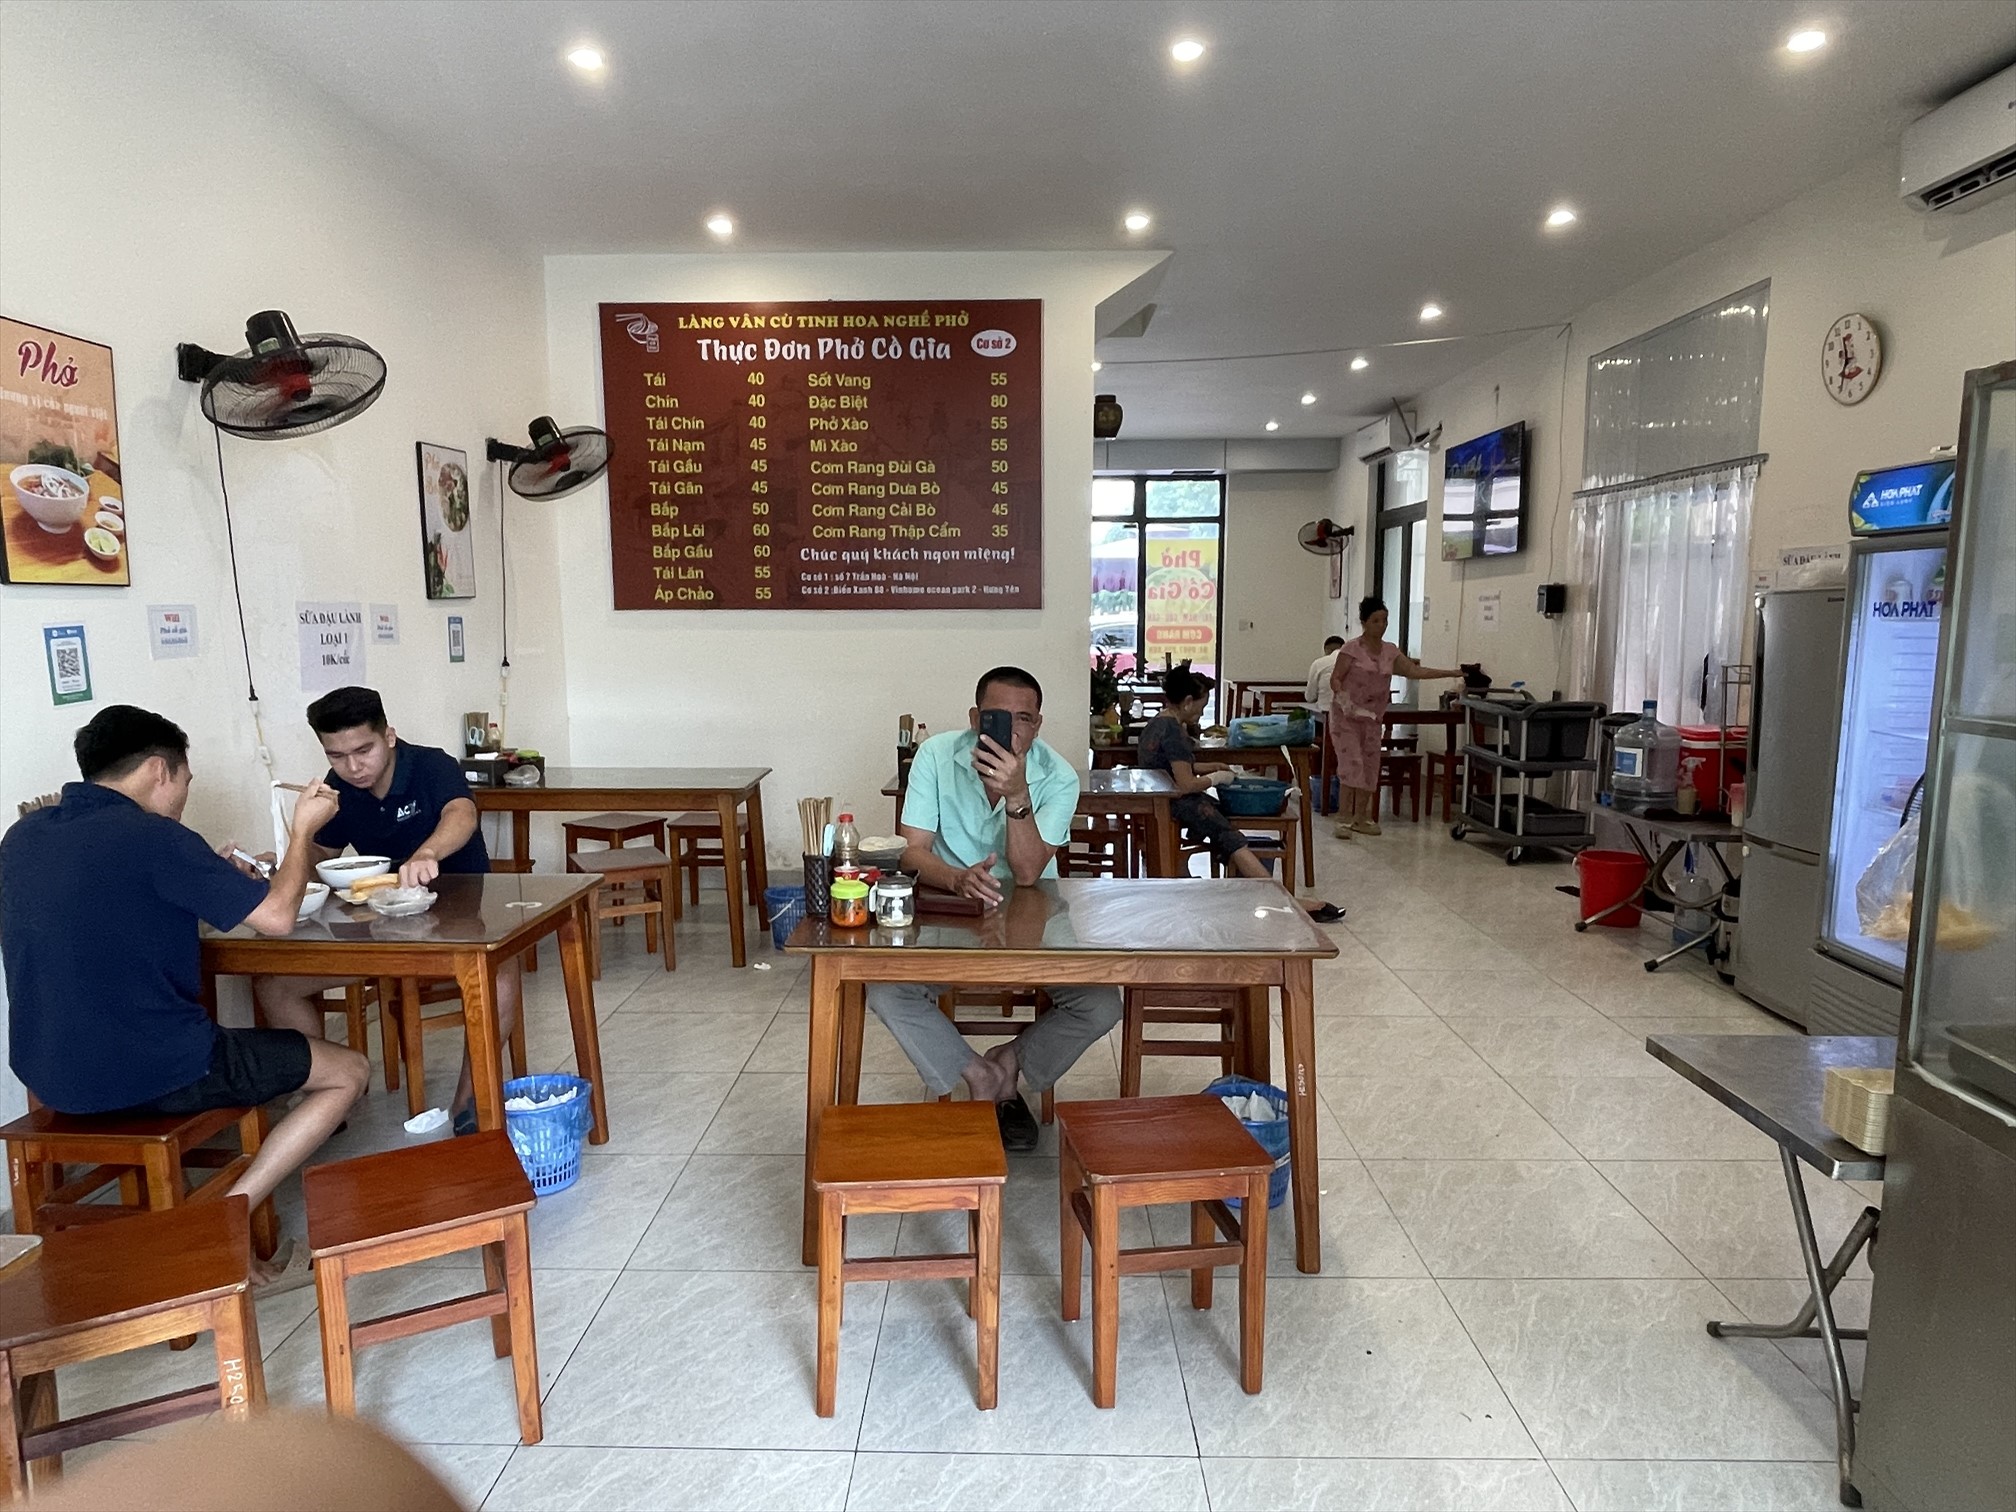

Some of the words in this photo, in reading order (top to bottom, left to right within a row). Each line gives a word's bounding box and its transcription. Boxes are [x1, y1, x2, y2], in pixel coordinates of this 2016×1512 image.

[678, 314, 724, 329] LÀNG
[729, 313, 766, 328] VÂN
[797, 316, 838, 328] TINH
[843, 314, 879, 327] HOA
[935, 310, 970, 326] PHỞ
[976, 338, 990, 349] Cơ
[991, 336, 1003, 349] sở
[1005, 338, 1011, 349] 2
[1867, 331, 1870, 340] 2
[697, 338, 757, 364] Thực
[764, 338, 810, 360] Đơn
[818, 336, 865, 360] Phở
[909, 337, 951, 360] Gia
[18, 340, 78, 387] Phở
[644, 372, 665, 386] Tái
[747, 372, 765, 385] 40
[808, 373, 832, 387] Sốt
[836, 374, 871, 389] Vang
[991, 373, 1007, 385] 55
[1860, 382, 1863, 391] 5
[646, 395, 679, 408] Chín
[748, 394, 765, 407] 40
[809, 395, 836, 412] Đặc
[840, 396, 868, 410] Biệt
[991, 395, 1008, 407] 80
[646, 416, 668, 430] Tái
[672, 416, 705, 430] Chín
[749, 416, 766, 428] 40
[810, 416, 838, 430] Phở
[841, 417, 869, 430] Xào
[991, 417, 1008, 429] 55
[647, 438, 669, 451] Tái
[672, 439, 705, 454] Nạm
[750, 438, 766, 450] 45
[830, 439, 858, 452] Xào
[991, 439, 1008, 451] 55
[649, 460, 670, 473] Tái
[751, 459, 767, 472] 45
[810, 461, 844, 474] Cơm
[848, 462, 885, 477] Rang
[889, 461, 912, 473] Đùi
[916, 460, 936, 473] Gà
[991, 461, 1008, 473] 50
[649, 482, 670, 495] Tái
[674, 481, 703, 495] Gân
[751, 481, 768, 493] 45
[811, 483, 844, 495] Cơm
[848, 483, 885, 498] Rang
[889, 483, 916, 495] Dưa
[920, 481, 940, 494] Bò
[992, 482, 1008, 494] 45
[1880, 488, 1900, 500] HOA
[651, 501, 679, 519] Bắp
[752, 502, 769, 515] 50
[812, 504, 844, 517] Cơm
[849, 504, 886, 519] Rang
[890, 502, 912, 516] Cải
[916, 503, 936, 516] Bò
[992, 504, 1008, 515] 45
[652, 522, 679, 539] Bắp
[683, 524, 705, 537] Lõi
[753, 524, 770, 536] 60
[813, 526, 845, 538] Cơm
[849, 526, 886, 540] Rang
[890, 525, 925, 540] Thập
[992, 525, 1008, 537] 35
[653, 544, 680, 560] Bắp
[754, 546, 770, 557] 60
[800, 548, 837, 561] Chúc
[842, 549, 869, 564] quý
[874, 547, 919, 561] khách
[924, 549, 960, 563] ngon
[964, 547, 1015, 563] miệng!
[654, 566, 674, 579] Tái
[678, 566, 704, 579] Lăn
[755, 566, 770, 578] 55
[654, 584, 673, 602] Áp
[677, 585, 714, 600] Chảo
[755, 588, 771, 599] 55
[299, 609, 318, 624] SỮA
[1873, 601, 1900, 618] HOA
[320, 633, 342, 647] LOẠI
